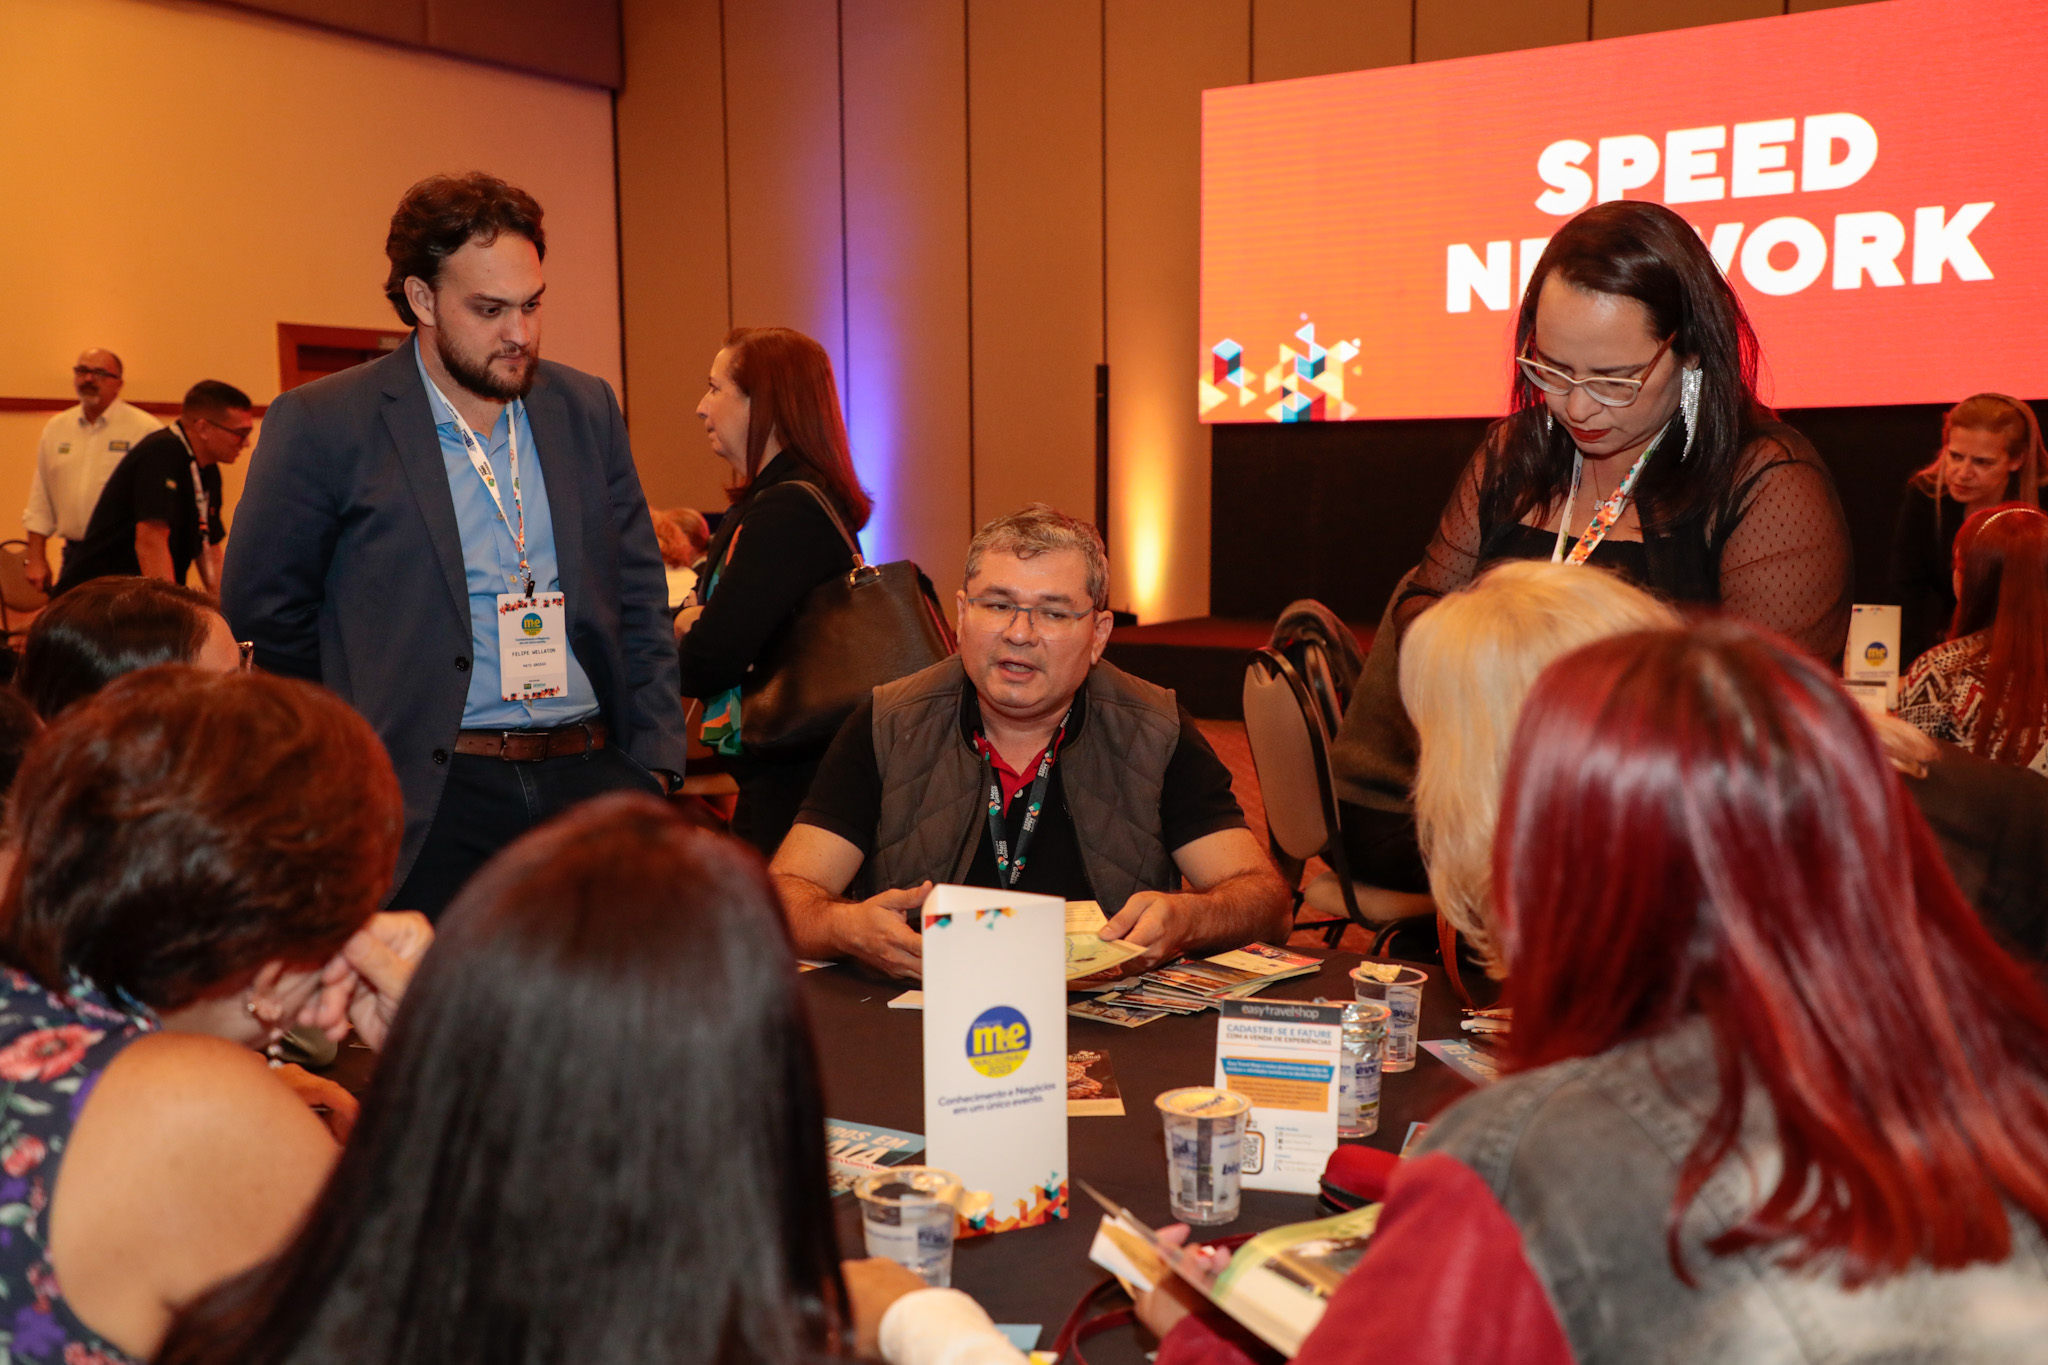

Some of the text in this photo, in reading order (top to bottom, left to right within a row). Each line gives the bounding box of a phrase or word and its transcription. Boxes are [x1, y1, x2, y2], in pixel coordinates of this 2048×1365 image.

[1535, 112, 1879, 216] SPEED
[1226, 1023, 1332, 1039] CADASTRE-SE E FATURE
[938, 1090, 1007, 1107] Conhecimento
[1015, 1083, 1056, 1095] Negócios
[953, 1106, 968, 1115] em
[969, 1104, 984, 1113] um
